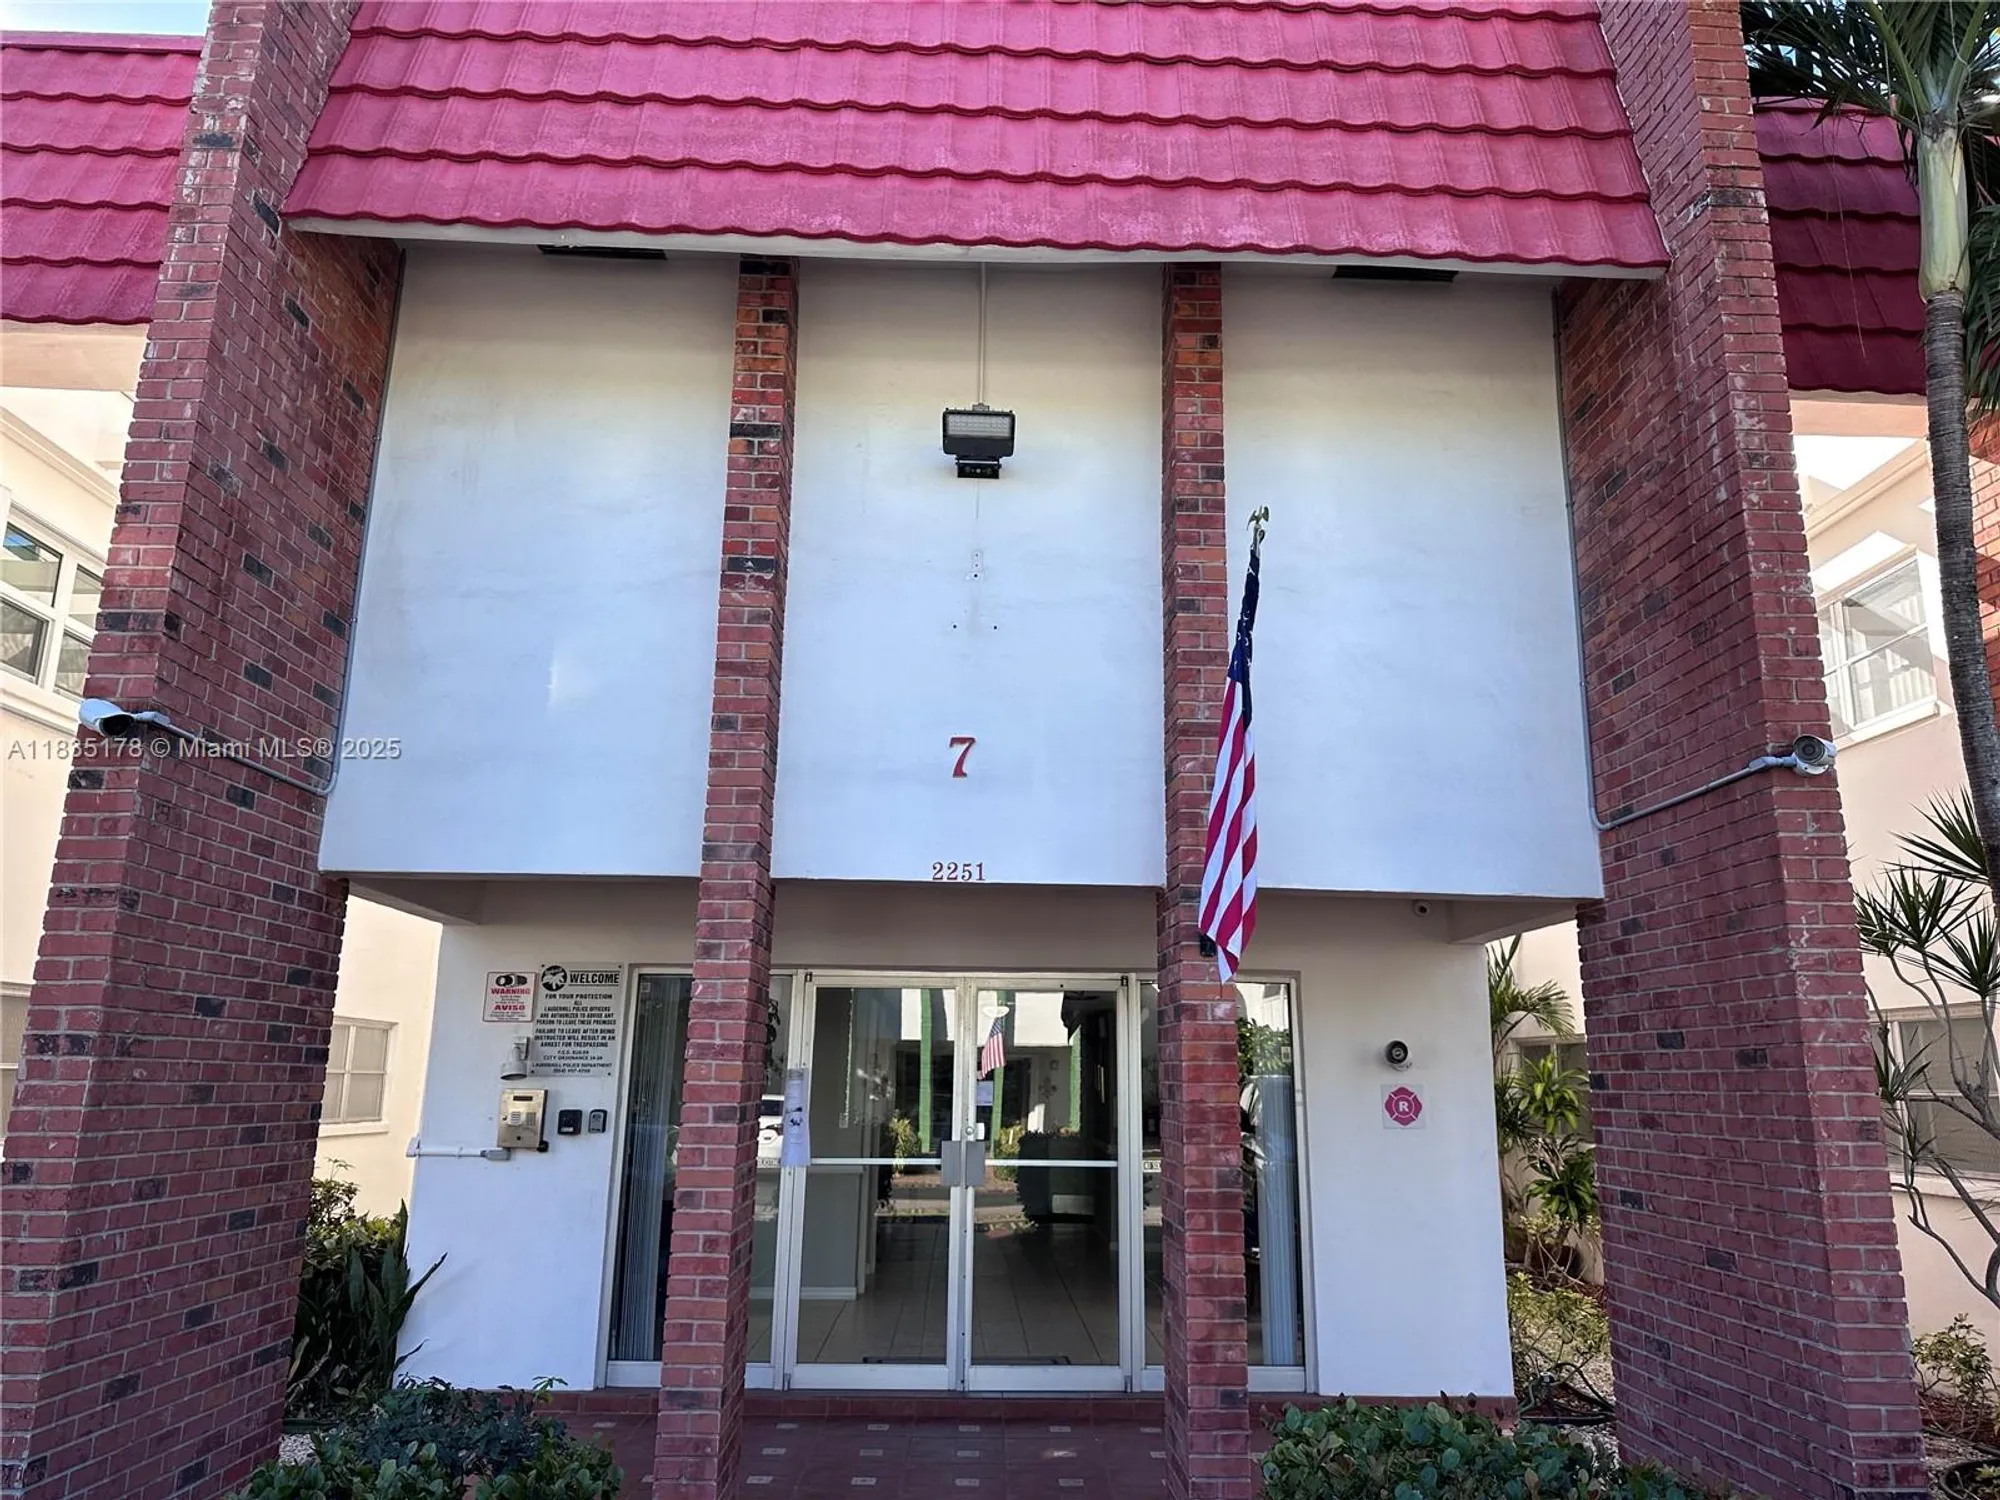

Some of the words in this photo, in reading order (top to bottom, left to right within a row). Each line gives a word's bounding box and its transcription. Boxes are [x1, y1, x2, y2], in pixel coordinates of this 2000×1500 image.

[949, 737, 976, 778] 7
[932, 862, 986, 881] 2251
[569, 973, 620, 984] WELCOME
[1399, 1101, 1409, 1112] R
